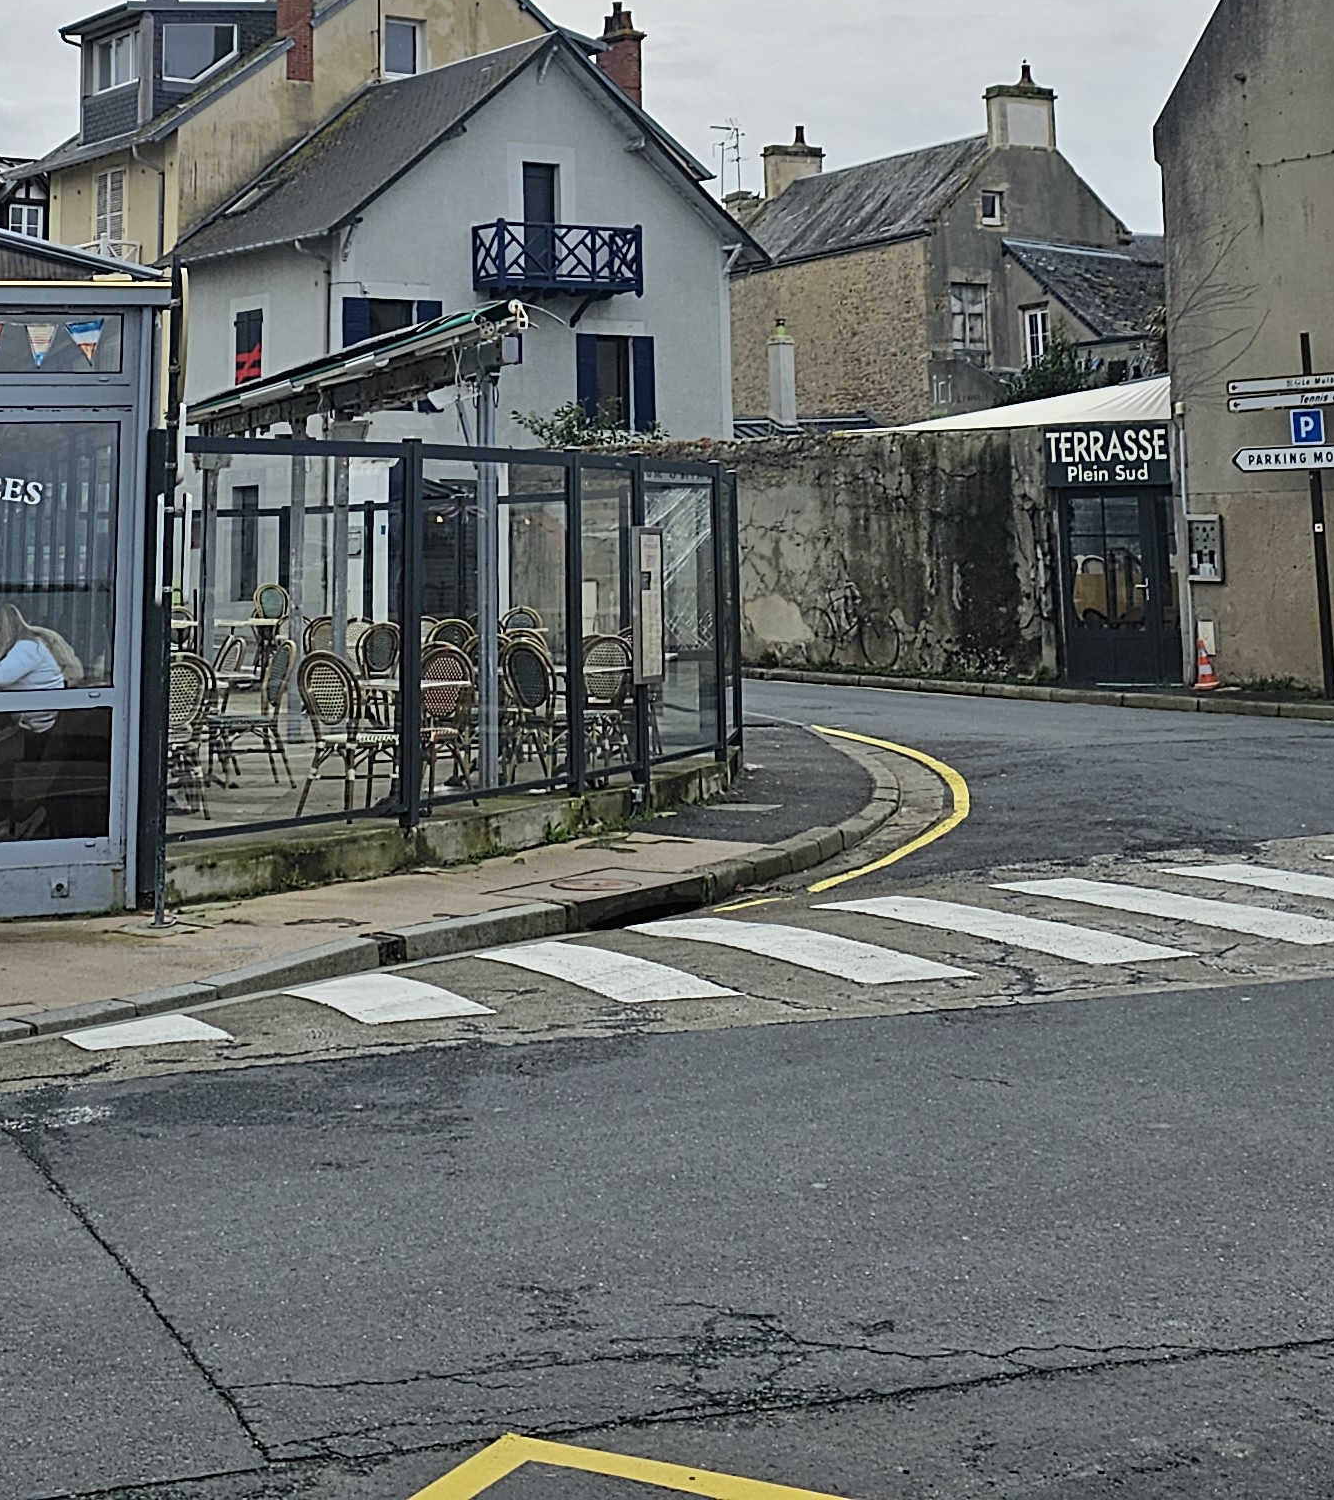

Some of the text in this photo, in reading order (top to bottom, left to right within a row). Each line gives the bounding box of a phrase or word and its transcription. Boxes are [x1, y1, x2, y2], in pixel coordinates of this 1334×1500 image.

[1300, 393, 1328, 404] Tennis
[1299, 415, 1315, 438] P
[1045, 428, 1168, 463] TERRASSE
[1248, 452, 1307, 466] PARKING
[1067, 462, 1149, 482] Plein Sud
